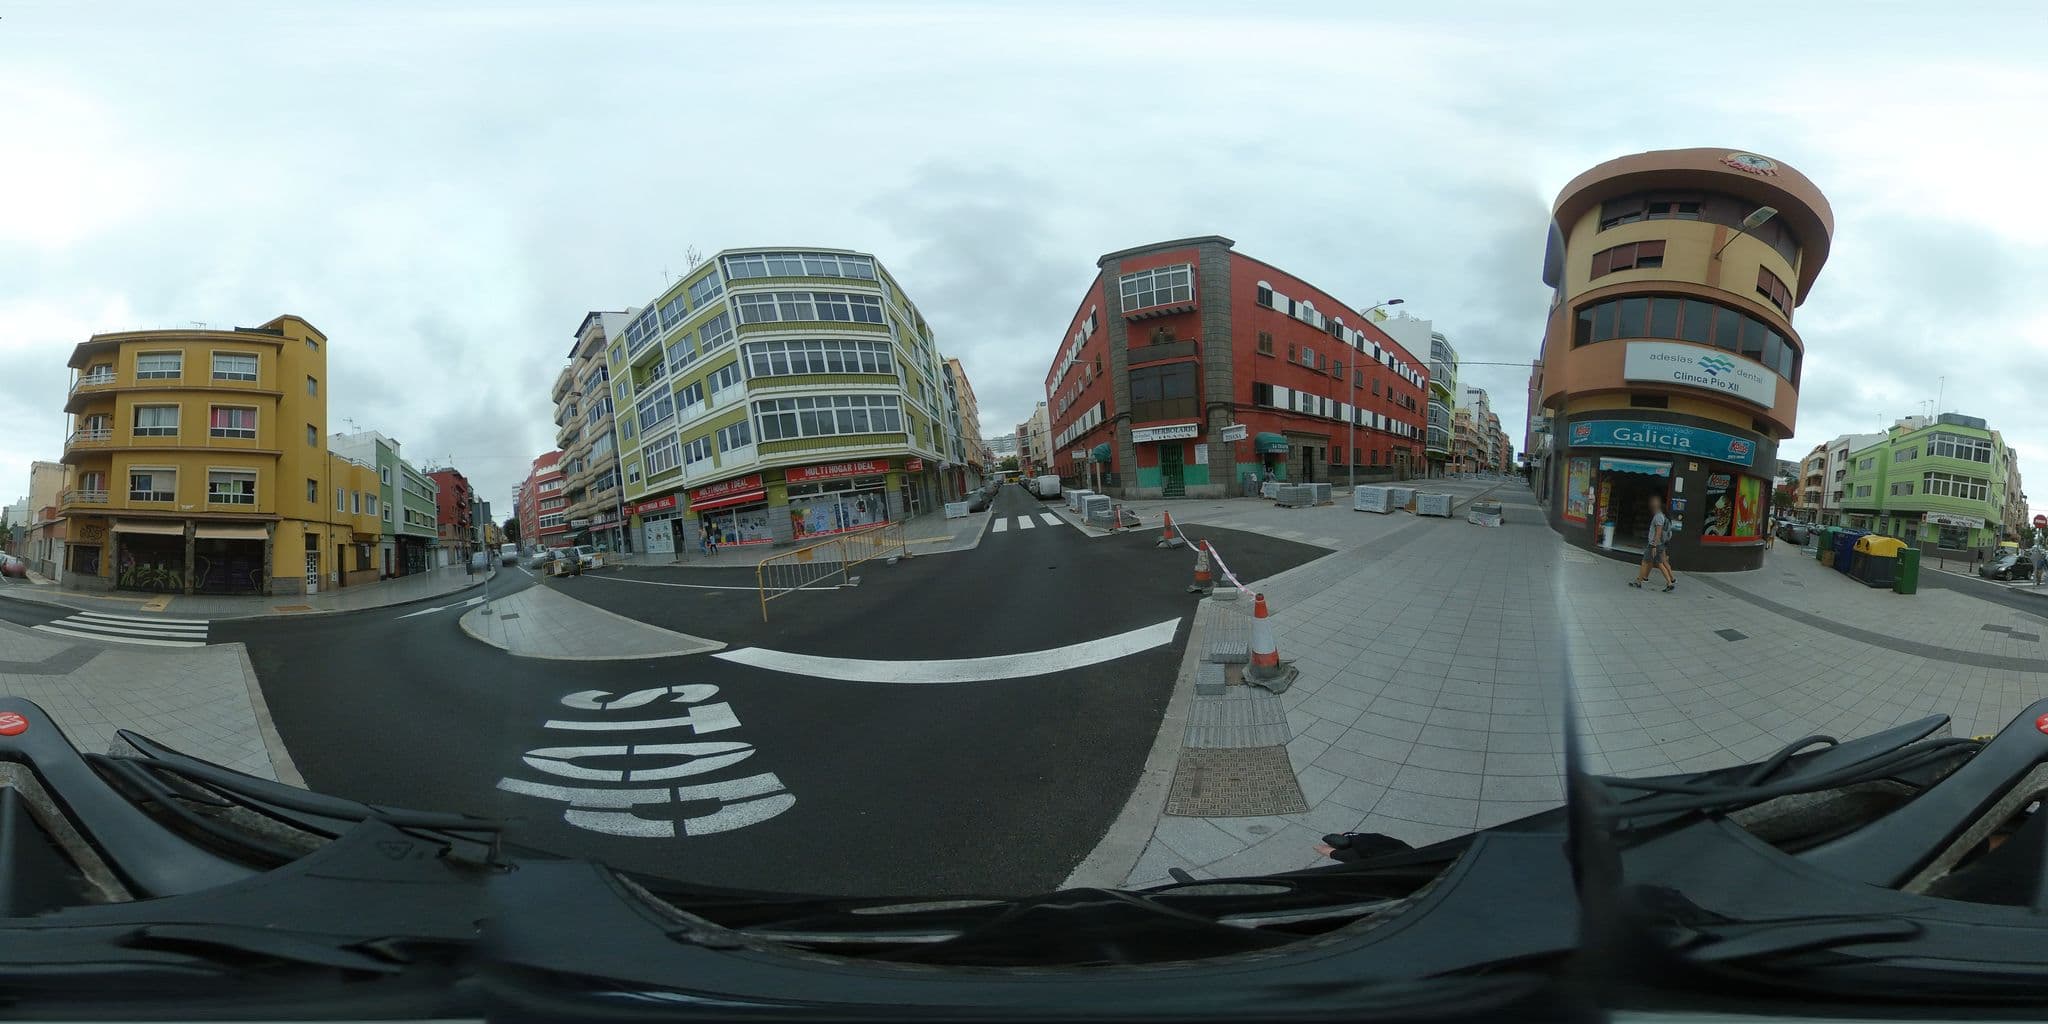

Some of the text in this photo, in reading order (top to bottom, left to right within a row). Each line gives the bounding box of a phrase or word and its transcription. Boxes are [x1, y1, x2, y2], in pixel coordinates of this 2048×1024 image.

[1736, 368, 1764, 384] dental
[1727, 382, 1739, 392] XII
[1613, 428, 1691, 447] Galicia
[854, 461, 875, 471] IDEAL
[731, 478, 748, 489] IDEAL
[496, 683, 797, 838] STOP
